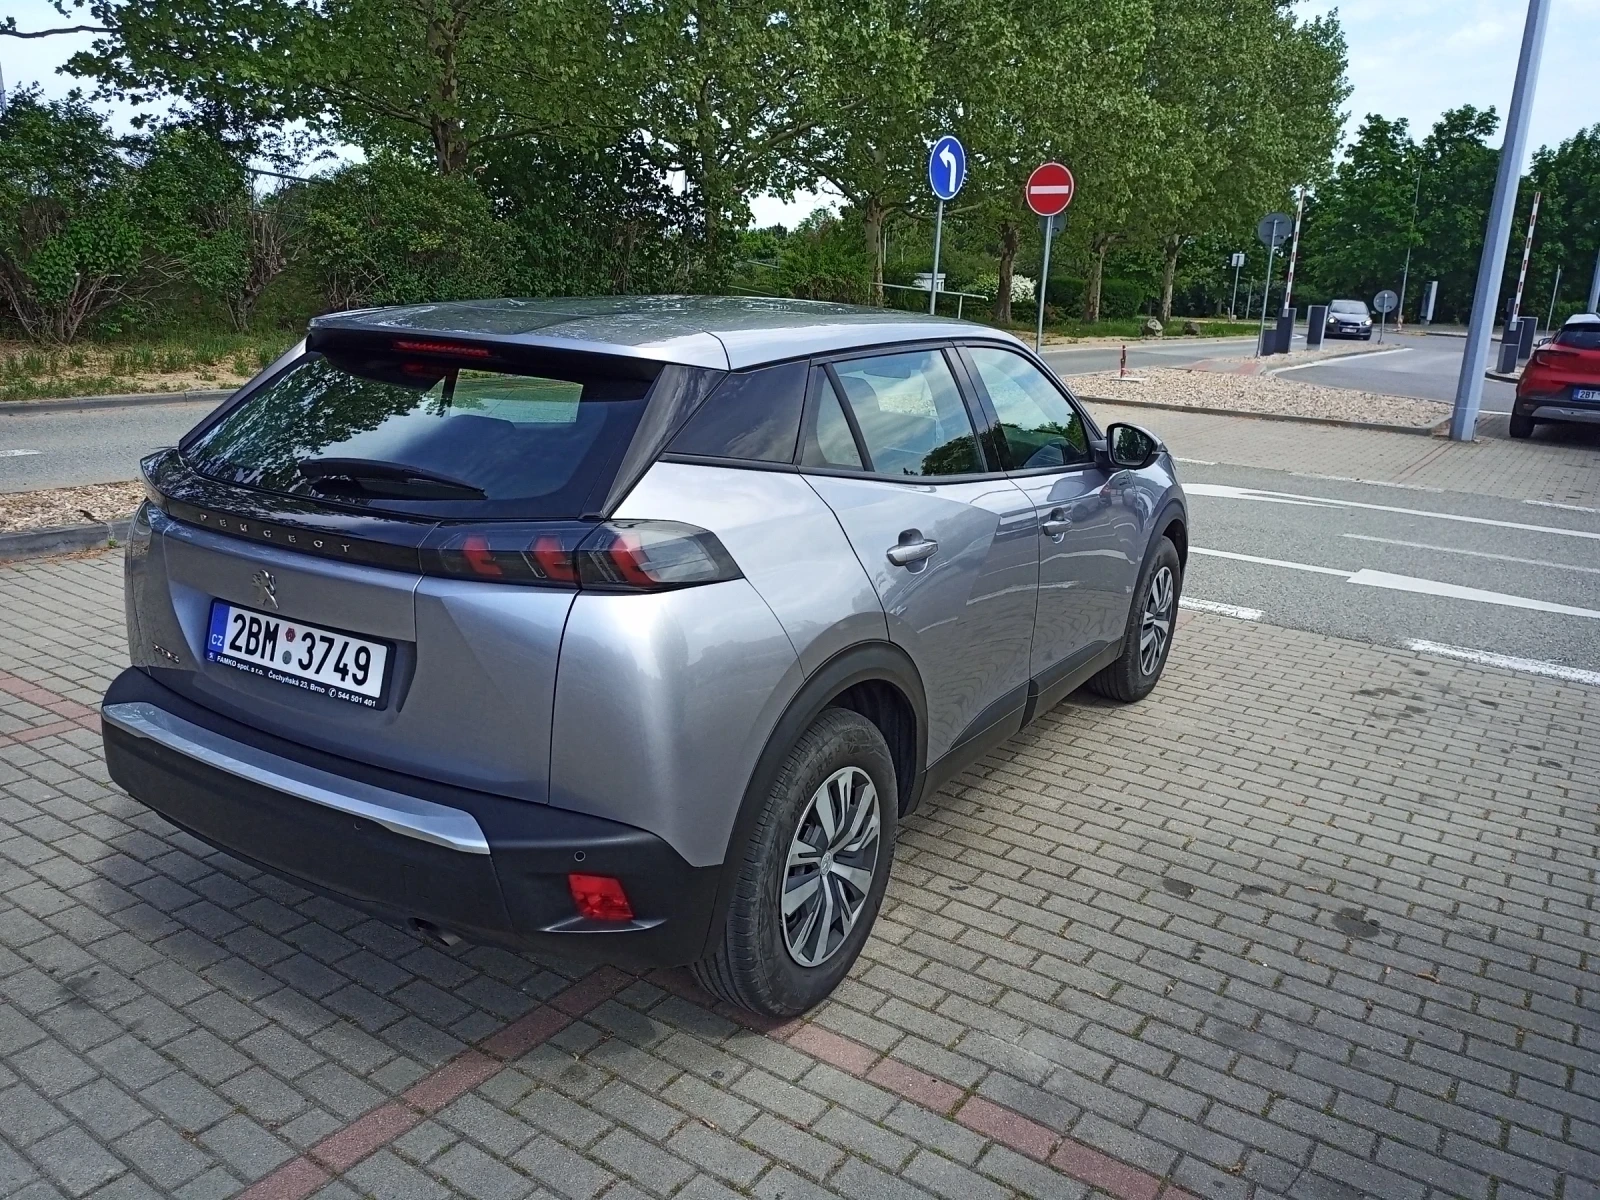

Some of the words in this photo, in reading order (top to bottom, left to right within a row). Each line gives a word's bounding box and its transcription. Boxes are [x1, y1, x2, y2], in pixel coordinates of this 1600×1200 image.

[199, 513, 351, 553] PEUGEOT
[211, 633, 223, 647] CZ
[229, 613, 280, 662] 2BM
[298, 631, 372, 686] 3749
[216, 655, 237, 667] FAMKO
[237, 663, 250, 672] spol.
[255, 668, 264, 676] r.o.
[300, 681, 309, 690] 23,
[310, 683, 325, 693] Brno
[337, 691, 349, 700] 544
[350, 695, 362, 703] 501
[363, 699, 376, 707] 401
